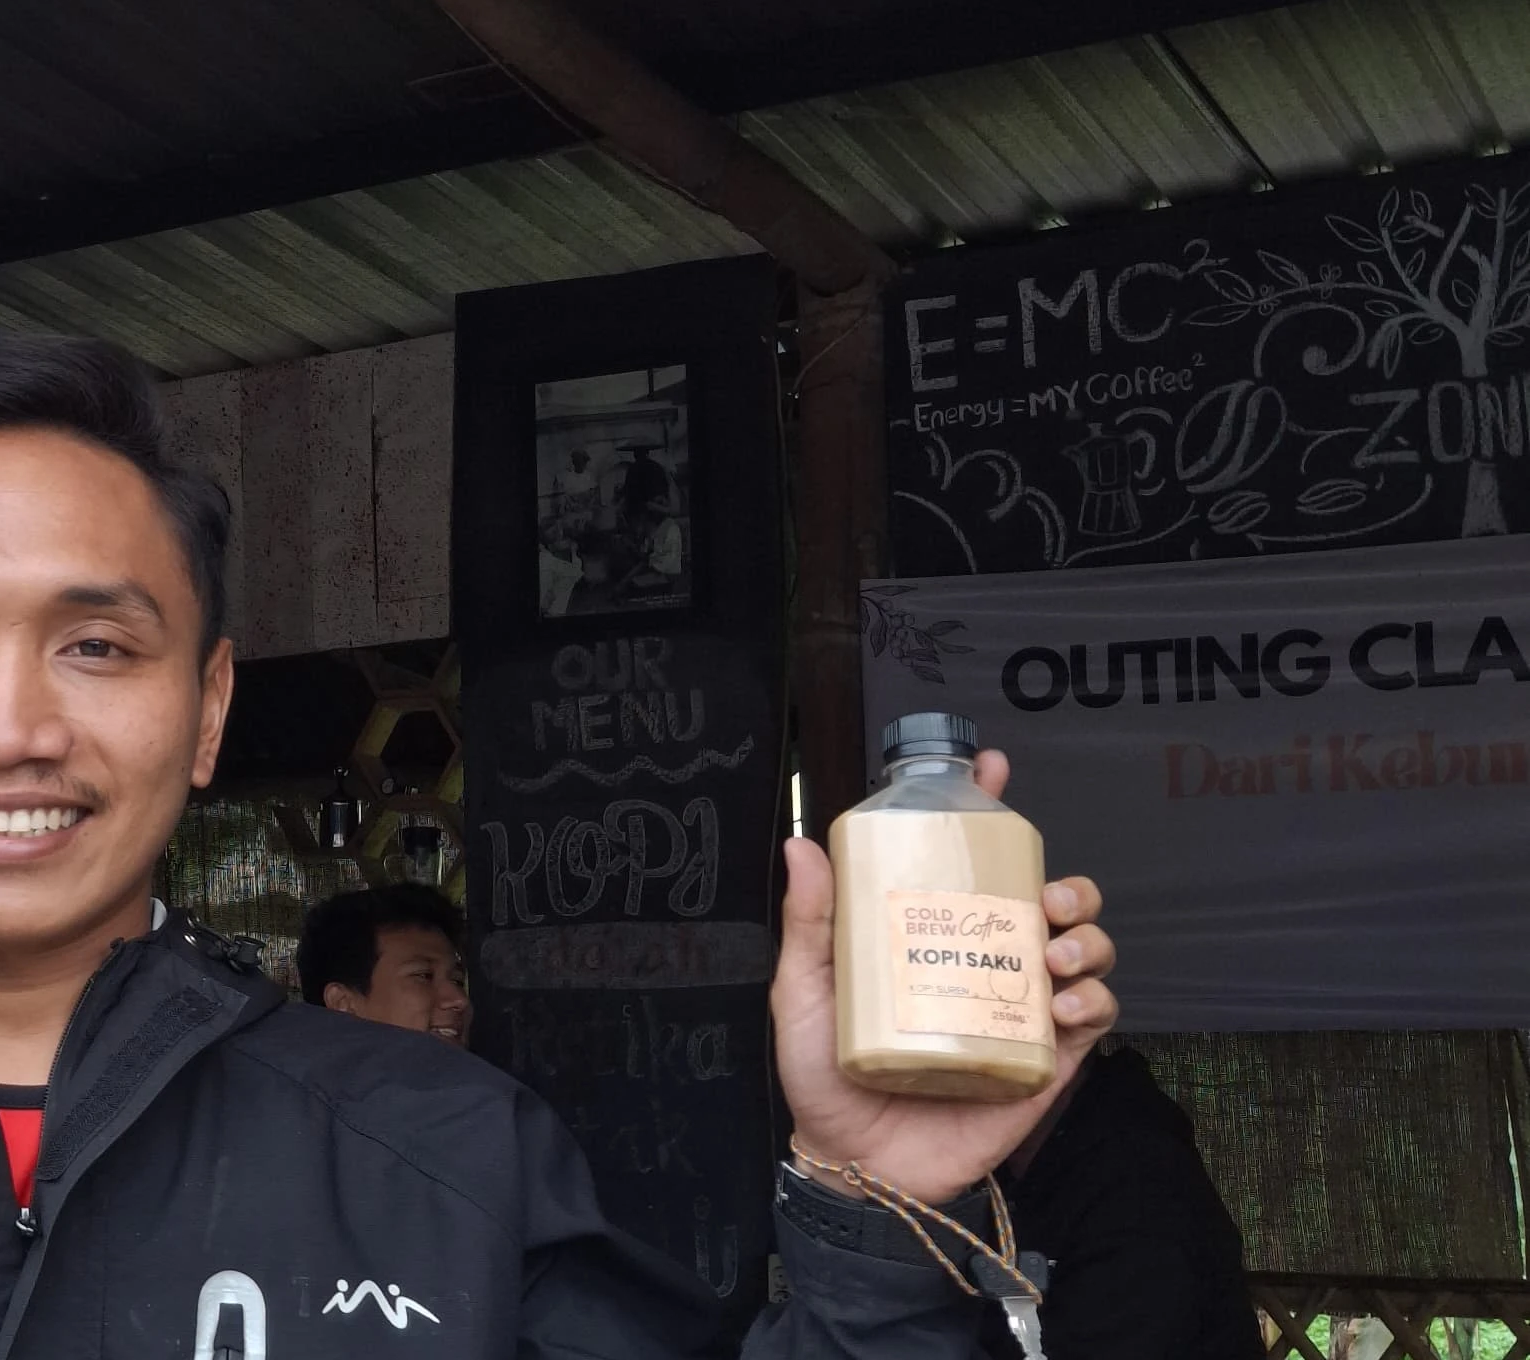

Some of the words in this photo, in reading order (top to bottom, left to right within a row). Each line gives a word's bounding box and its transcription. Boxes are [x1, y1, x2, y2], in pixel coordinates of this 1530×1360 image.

[551, 635, 673, 692] OUR
[1001, 628, 1331, 712] OUTING
[531, 687, 706, 752] MENU
[1165, 732, 1313, 799] Dari
[1328, 729, 1530, 791] Kebun
[904, 907, 954, 922] COLD
[959, 910, 1016, 942] Coffee
[905, 921, 958, 937] BREW
[907, 947, 962, 967] KOPI
[965, 951, 1023, 973] SAKU
